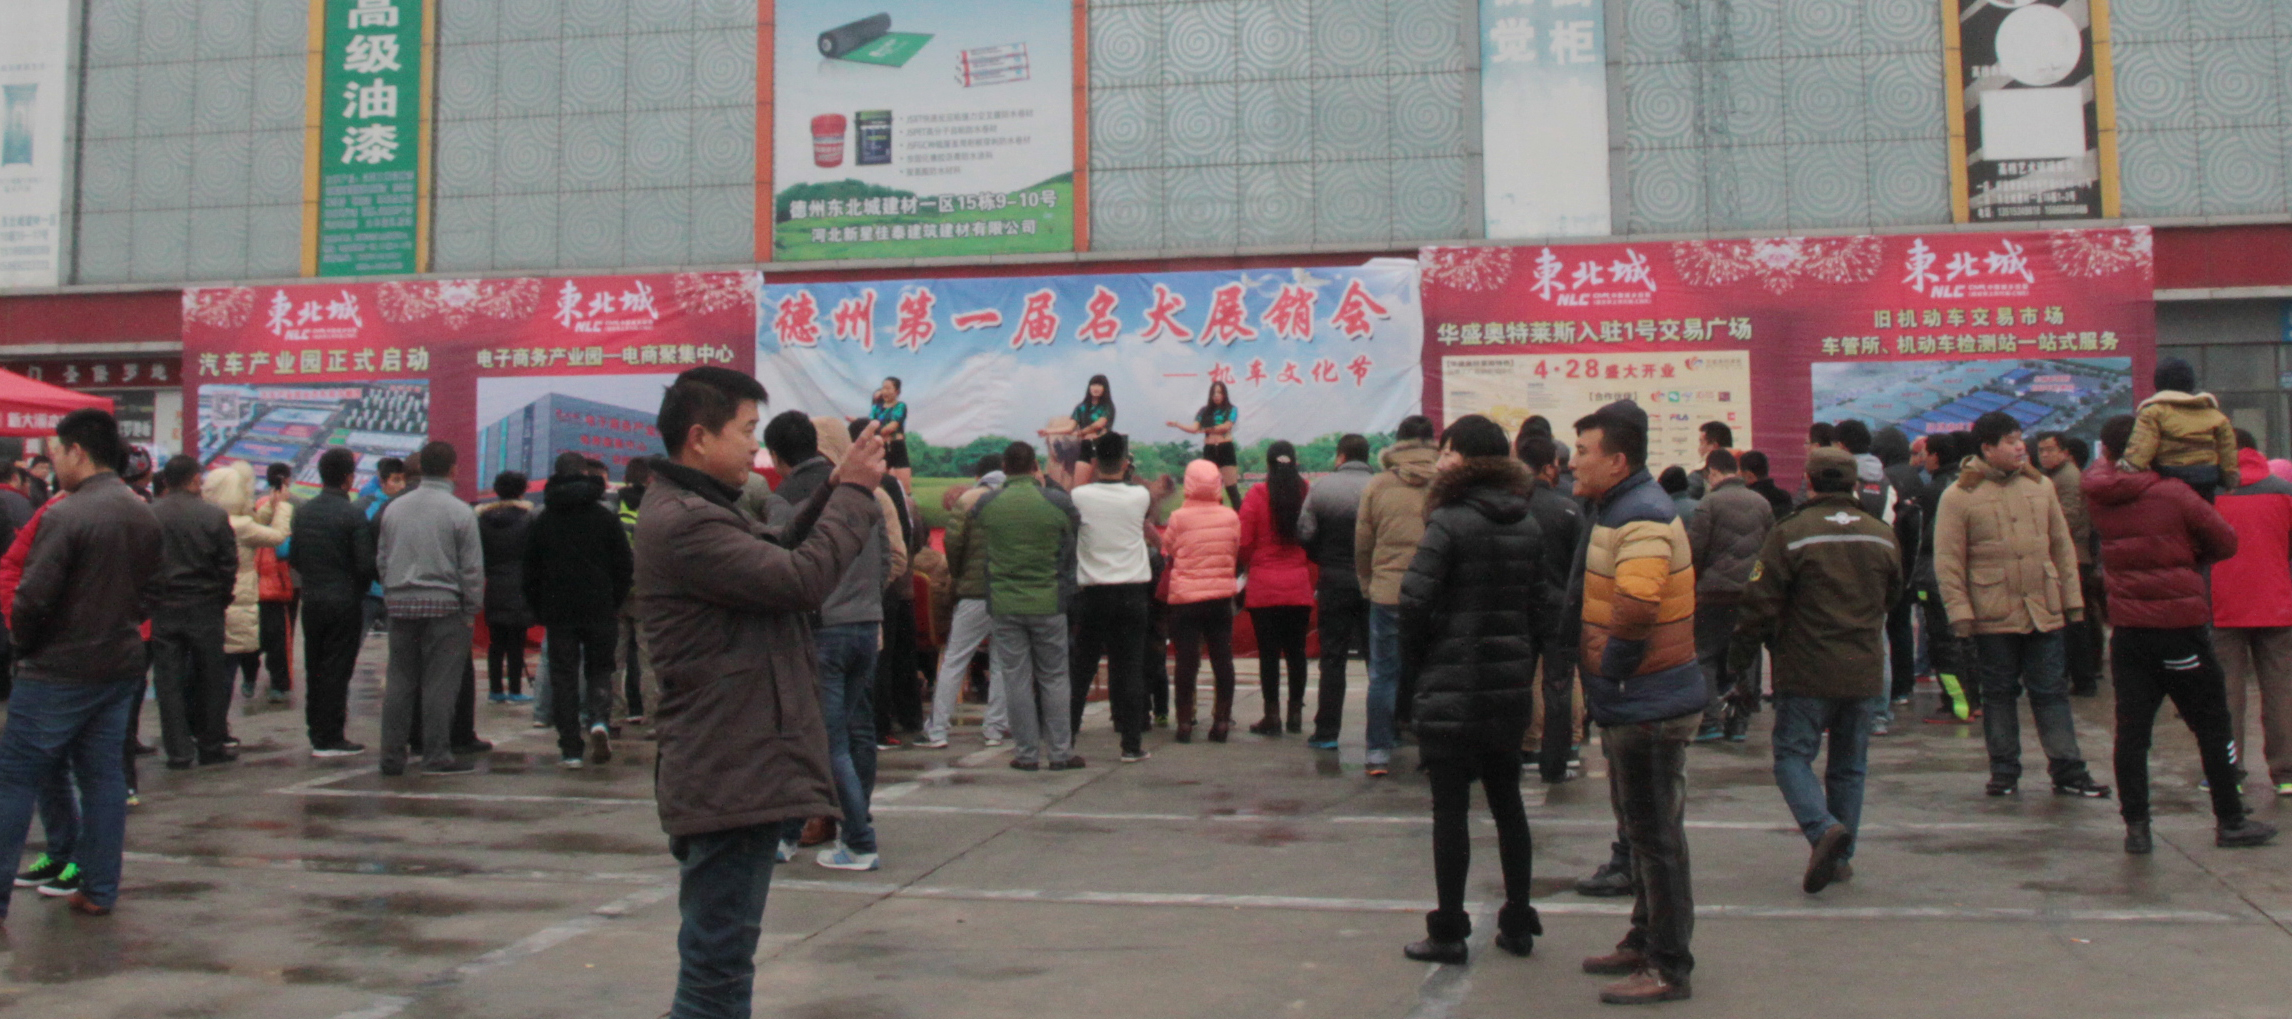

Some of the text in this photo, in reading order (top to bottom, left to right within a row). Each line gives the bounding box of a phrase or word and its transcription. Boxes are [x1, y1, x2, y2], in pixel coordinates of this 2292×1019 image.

[1556, 293, 1590, 306] NLC
[1930, 285, 1966, 298] NLC
[574, 319, 602, 333] NLC
[773, 279, 1391, 350] 德州第一届名犬展销会
[1873, 305, 2065, 329] 旧机动车交易市场
[1437, 316, 1752, 346] 华盛奥特莱斯入驻1号交易广场
[1821, 332, 2120, 356] 车管所、机动车检测站一站式服务
[199, 345, 430, 377] 汽车产业园正式启动
[1604, 363, 1676, 379] 盛大开业
